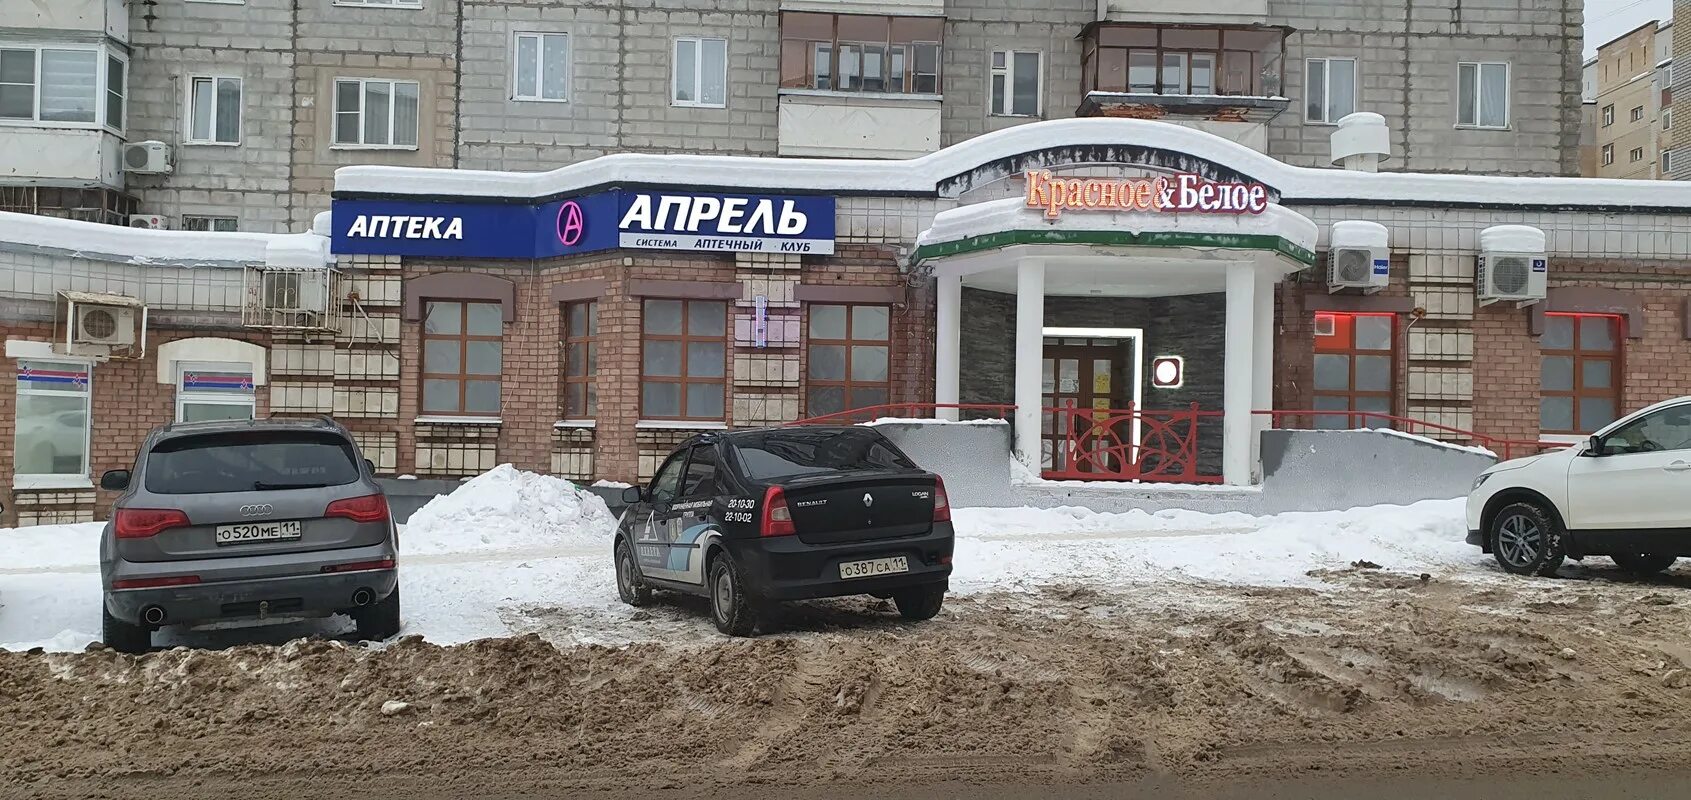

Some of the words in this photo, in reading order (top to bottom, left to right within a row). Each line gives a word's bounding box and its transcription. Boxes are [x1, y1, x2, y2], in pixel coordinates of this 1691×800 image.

[1027, 170, 1267, 215] Красное&Белое
[618, 194, 808, 236] АПРЕЛЬ
[346, 215, 463, 240] АПТЕКА
[635, 238, 678, 248] СИСТЕМА
[693, 238, 763, 251] АПТЕЧНЫЙ
[780, 242, 811, 252] КЛУБ
[727, 499, 755, 509] 20-10-30
[797, 499, 827, 507] RENAULT
[724, 511, 752, 523] 22-10-02
